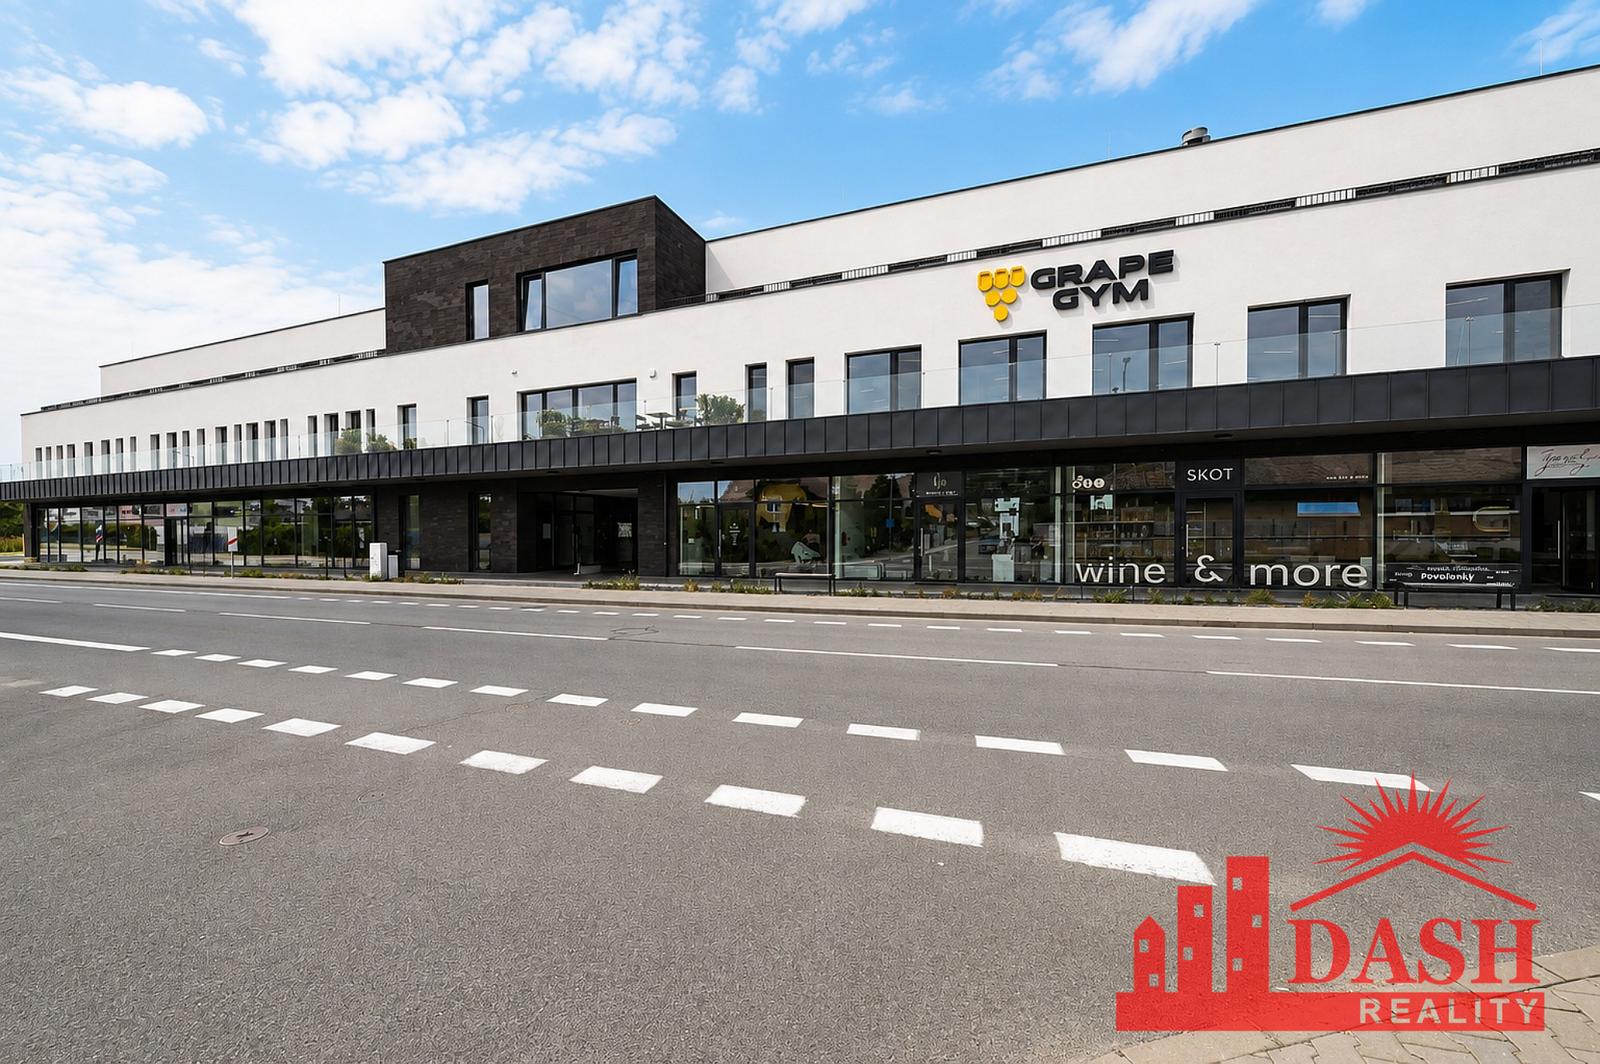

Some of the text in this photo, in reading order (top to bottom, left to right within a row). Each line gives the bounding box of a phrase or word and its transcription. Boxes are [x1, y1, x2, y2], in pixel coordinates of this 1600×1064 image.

[1031, 249, 1174, 290] GRAPE
[1052, 279, 1149, 310] GYM
[1187, 468, 1233, 482] SKOT
[1075, 554, 1368, 587] wine & more
